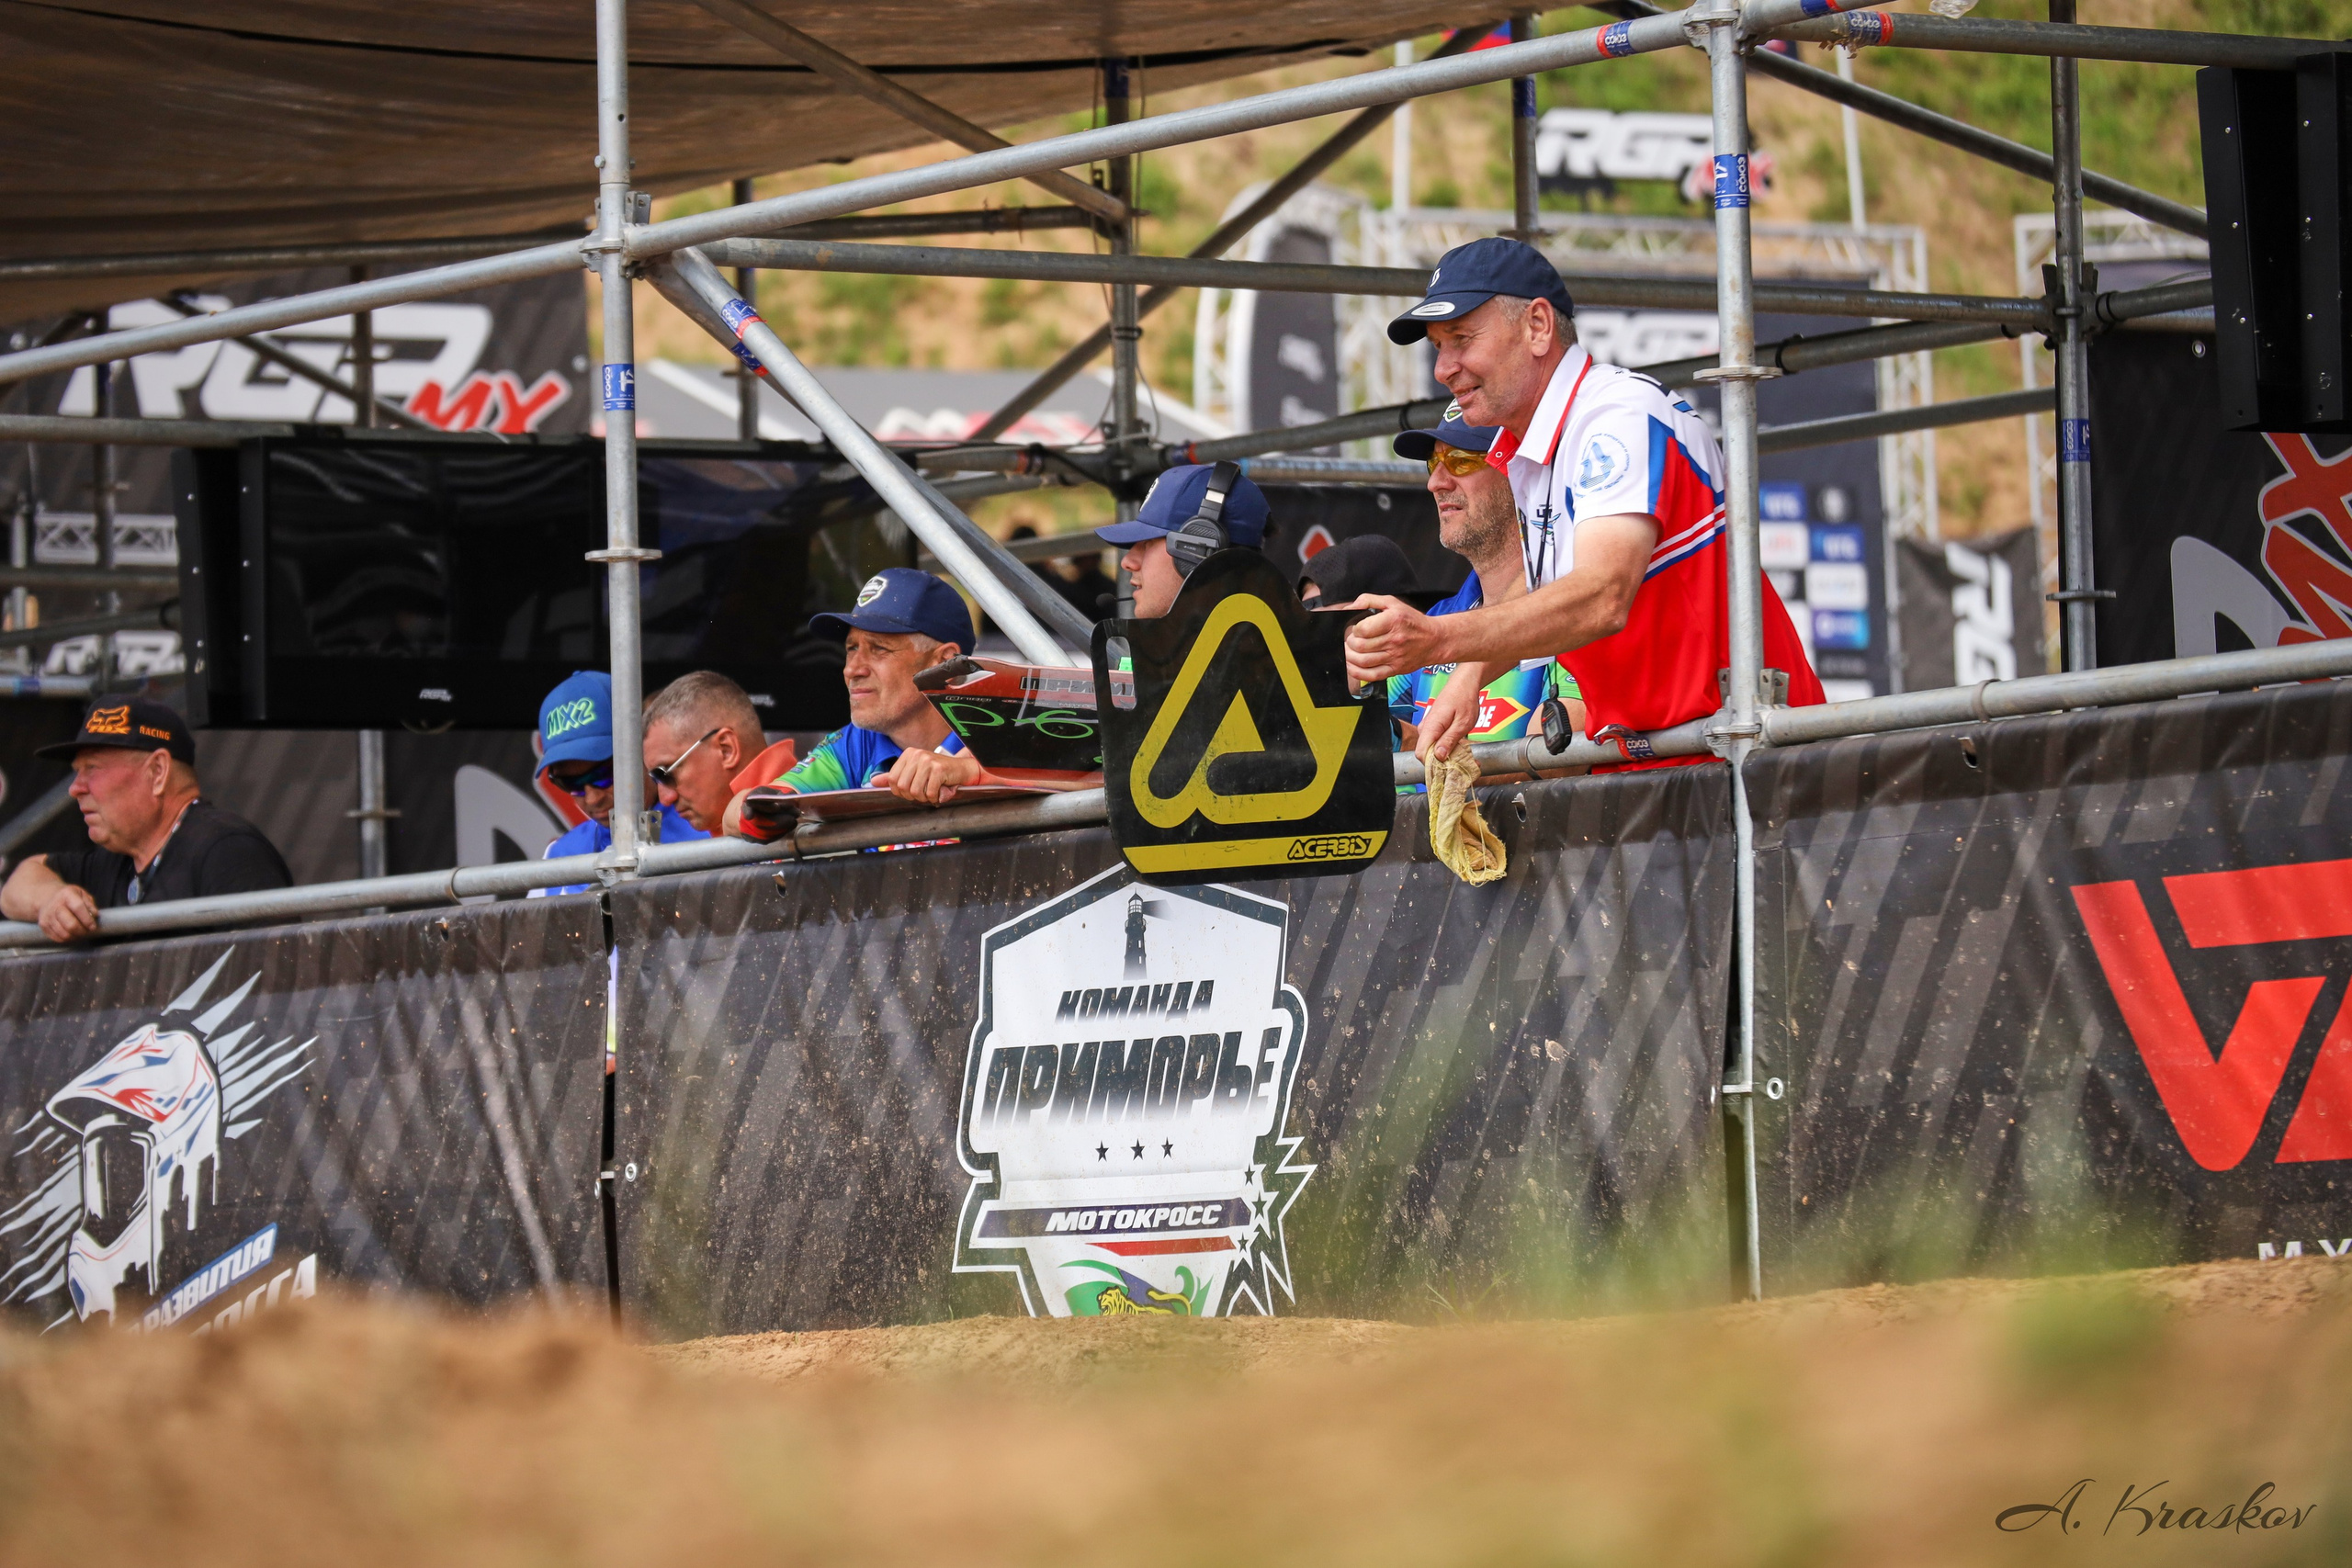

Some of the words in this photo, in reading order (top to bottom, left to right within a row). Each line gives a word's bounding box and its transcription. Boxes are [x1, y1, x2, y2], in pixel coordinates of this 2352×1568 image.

[139, 725, 171, 741] RACING
[547, 696, 595, 739] MX2
[1055, 979, 1215, 1023] КОМАНДА
[979, 1026, 1283, 1130] ПРИМОРЬЕ
[1046, 1203, 1223, 1232] МОТОКРОСС
